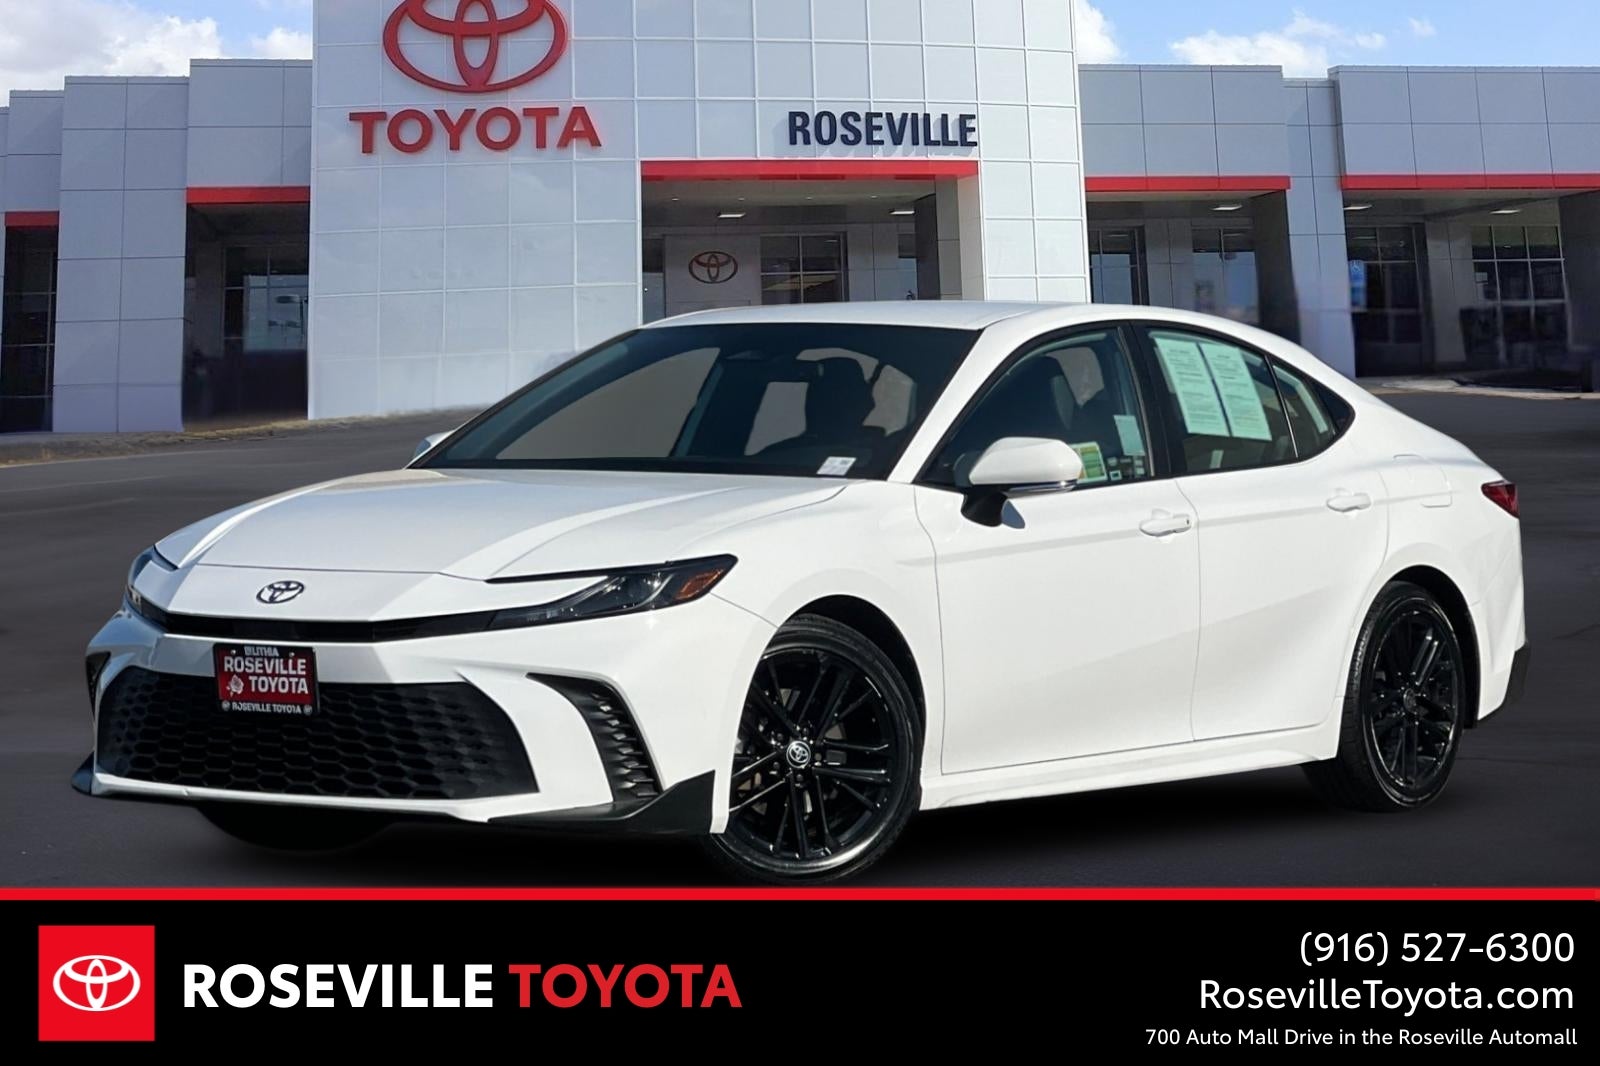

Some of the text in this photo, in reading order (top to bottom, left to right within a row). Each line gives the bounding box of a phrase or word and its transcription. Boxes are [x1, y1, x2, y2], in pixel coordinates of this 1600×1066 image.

[349, 106, 602, 154] TOYOTA
[788, 111, 978, 148] ROSEVILLE
[223, 656, 306, 675] ROSEVILLE
[248, 676, 309, 694] TOYOTA
[232, 702, 302, 714] ROSEVILLE TOYOTA
